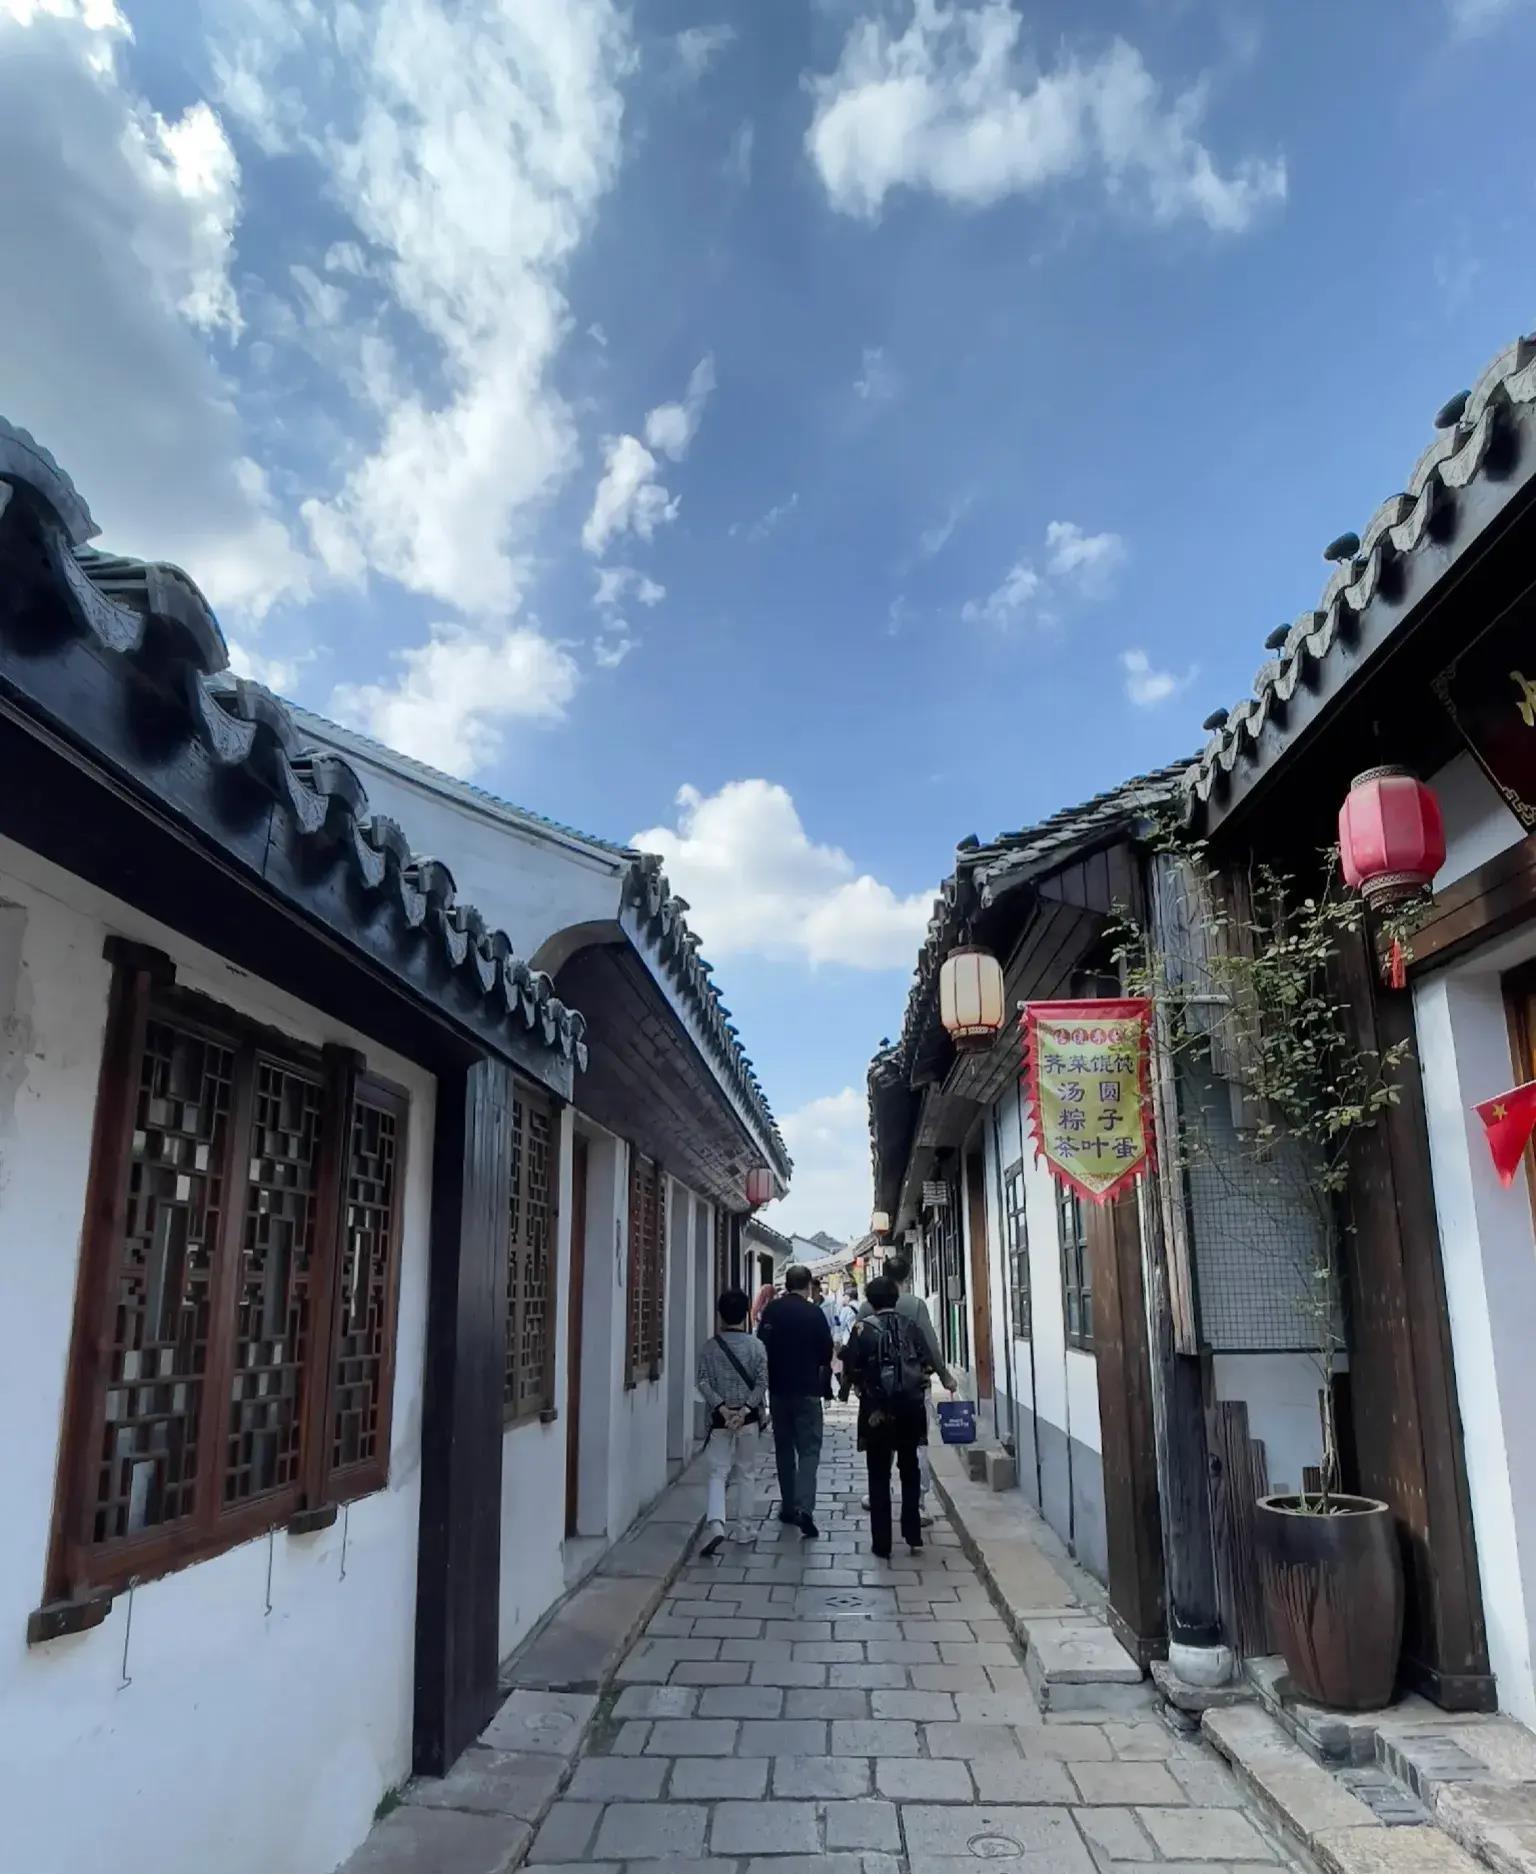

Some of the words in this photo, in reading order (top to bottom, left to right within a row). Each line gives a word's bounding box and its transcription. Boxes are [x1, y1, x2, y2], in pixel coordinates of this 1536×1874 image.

[1044, 1054, 1135, 1075] 荠菜馄饨
[1057, 1081, 1121, 1102] 汤圆
[1058, 1108, 1123, 1131] 粽子
[1053, 1136, 1138, 1159] 茶叶蛋
